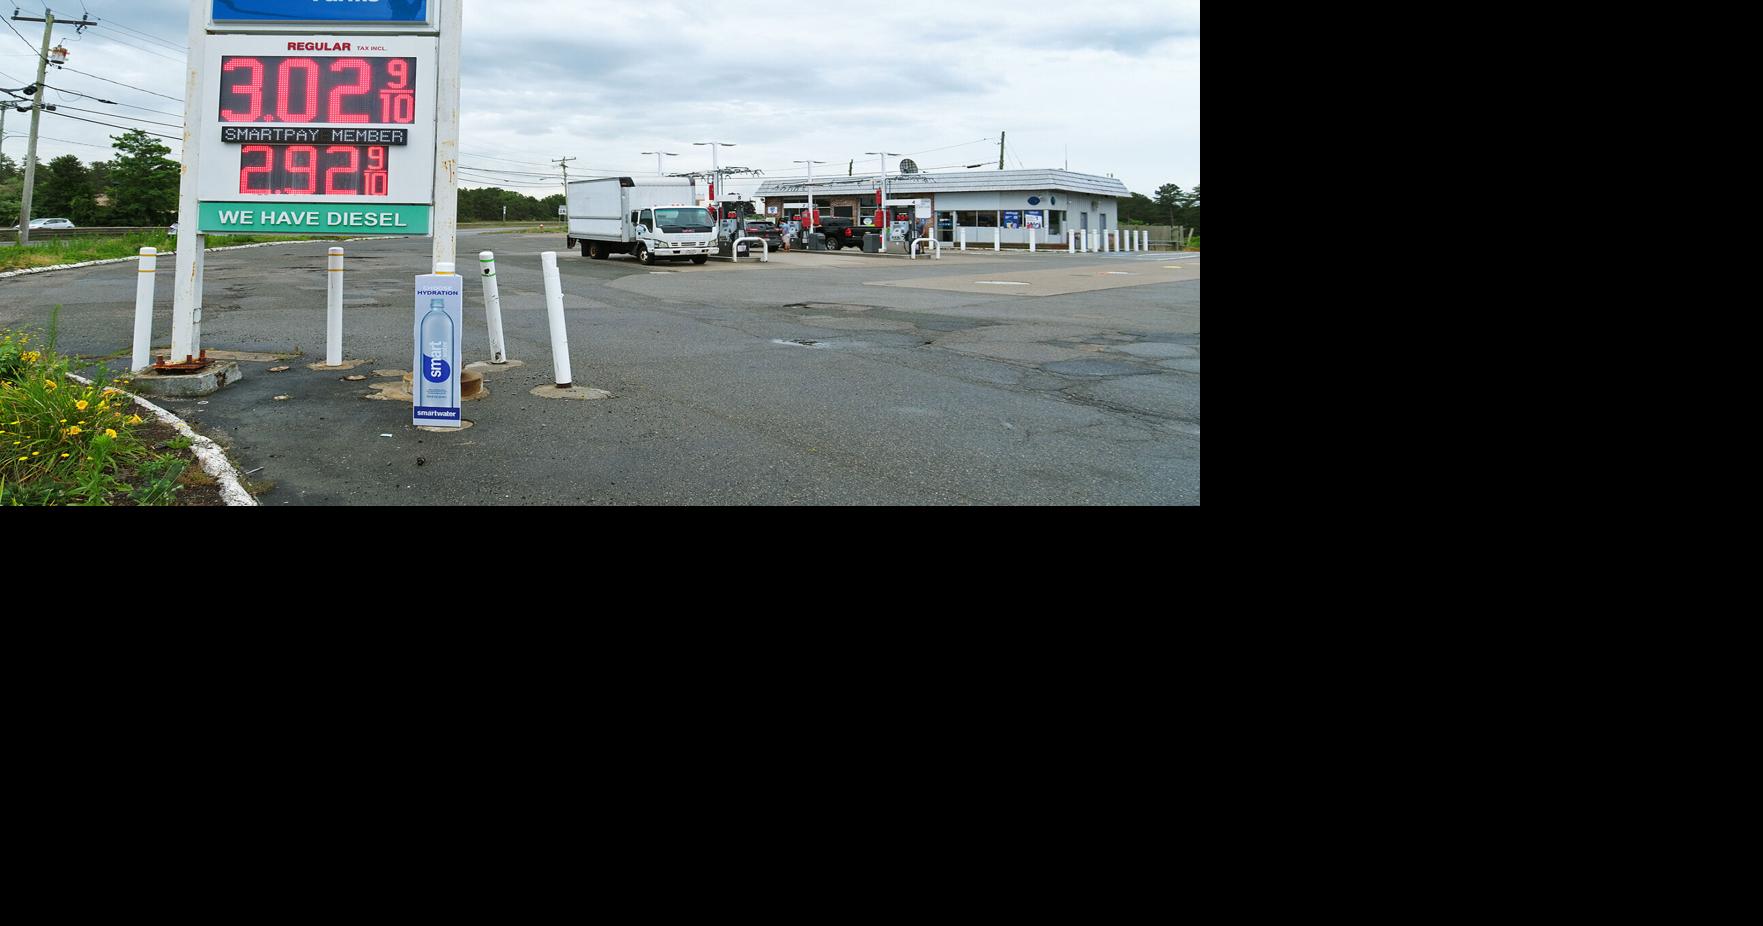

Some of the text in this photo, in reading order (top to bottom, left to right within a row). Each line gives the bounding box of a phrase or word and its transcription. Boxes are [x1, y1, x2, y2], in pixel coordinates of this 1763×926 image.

[287, 42, 351, 51] REGULAR
[221, 57, 408, 123] 3.02 9
[379, 93, 414, 123] 10
[224, 128, 403, 143] SMARTPAY MEMBER
[240, 145, 360, 195] 2.92
[218, 210, 407, 227] WE HAVE DIESEL
[428, 340, 442, 378] smart
[416, 409, 457, 417] smartwater
